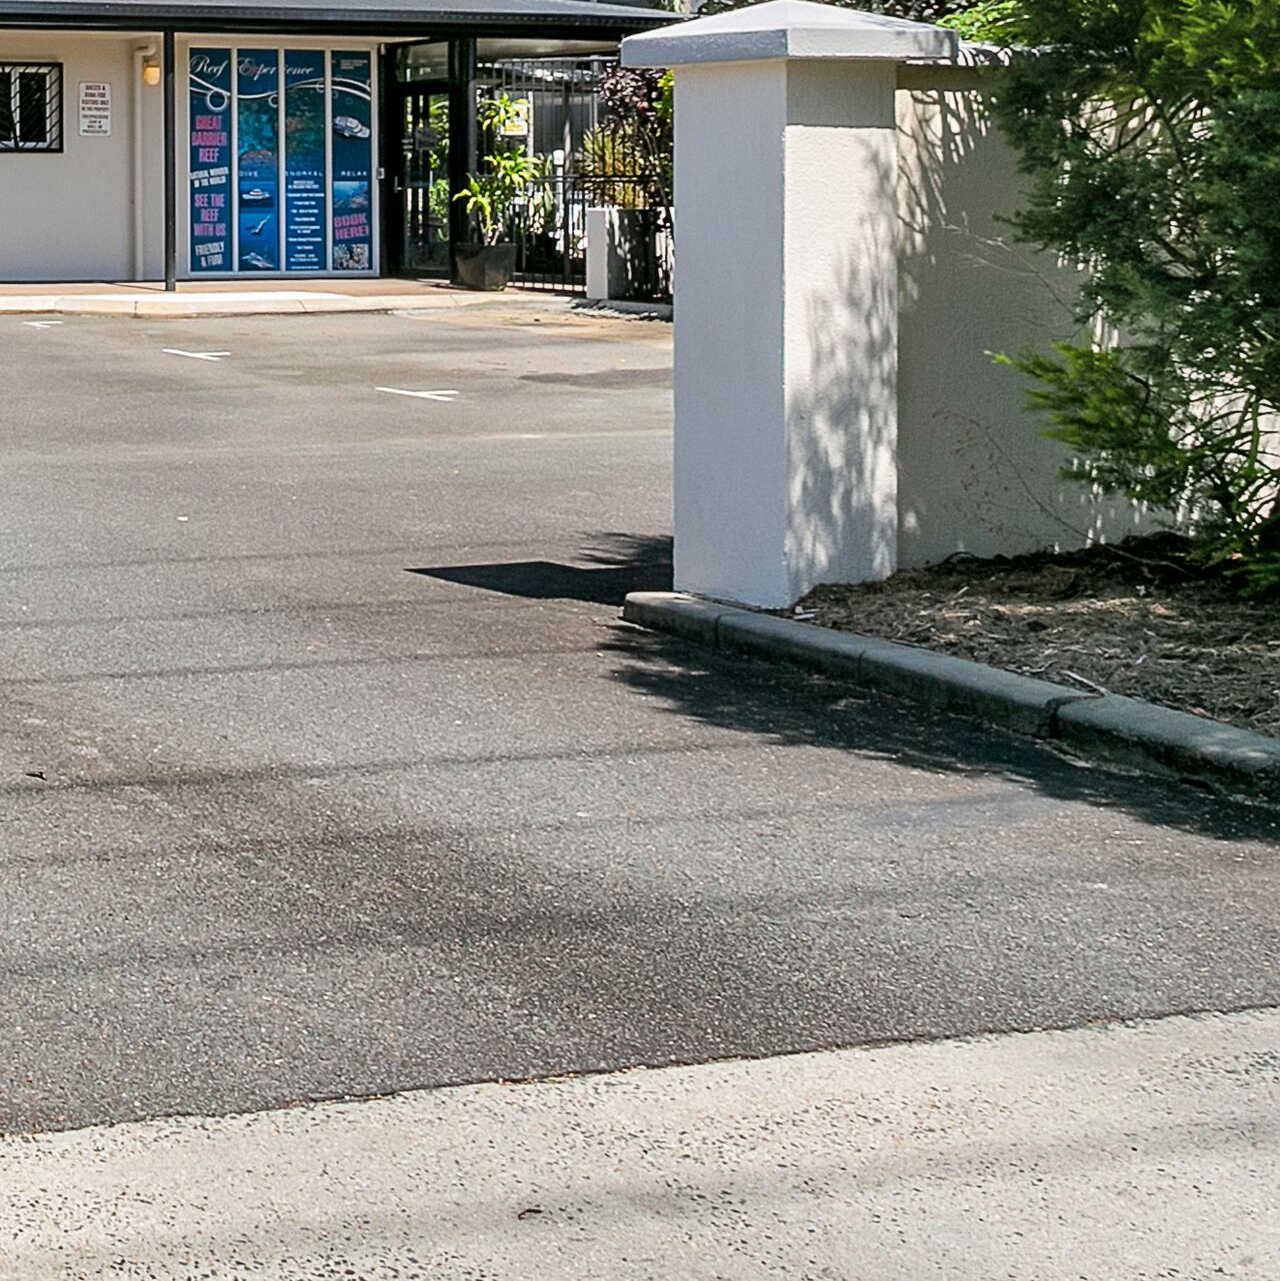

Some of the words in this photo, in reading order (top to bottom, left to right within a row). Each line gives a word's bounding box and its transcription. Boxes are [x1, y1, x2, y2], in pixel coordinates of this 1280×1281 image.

[189, 55, 228, 80] Reef
[199, 148, 219, 162] REEF
[194, 193, 208, 207] SEE
[210, 193, 225, 207] THE
[200, 208, 219, 221] REEF
[334, 213, 367, 227] BOOK
